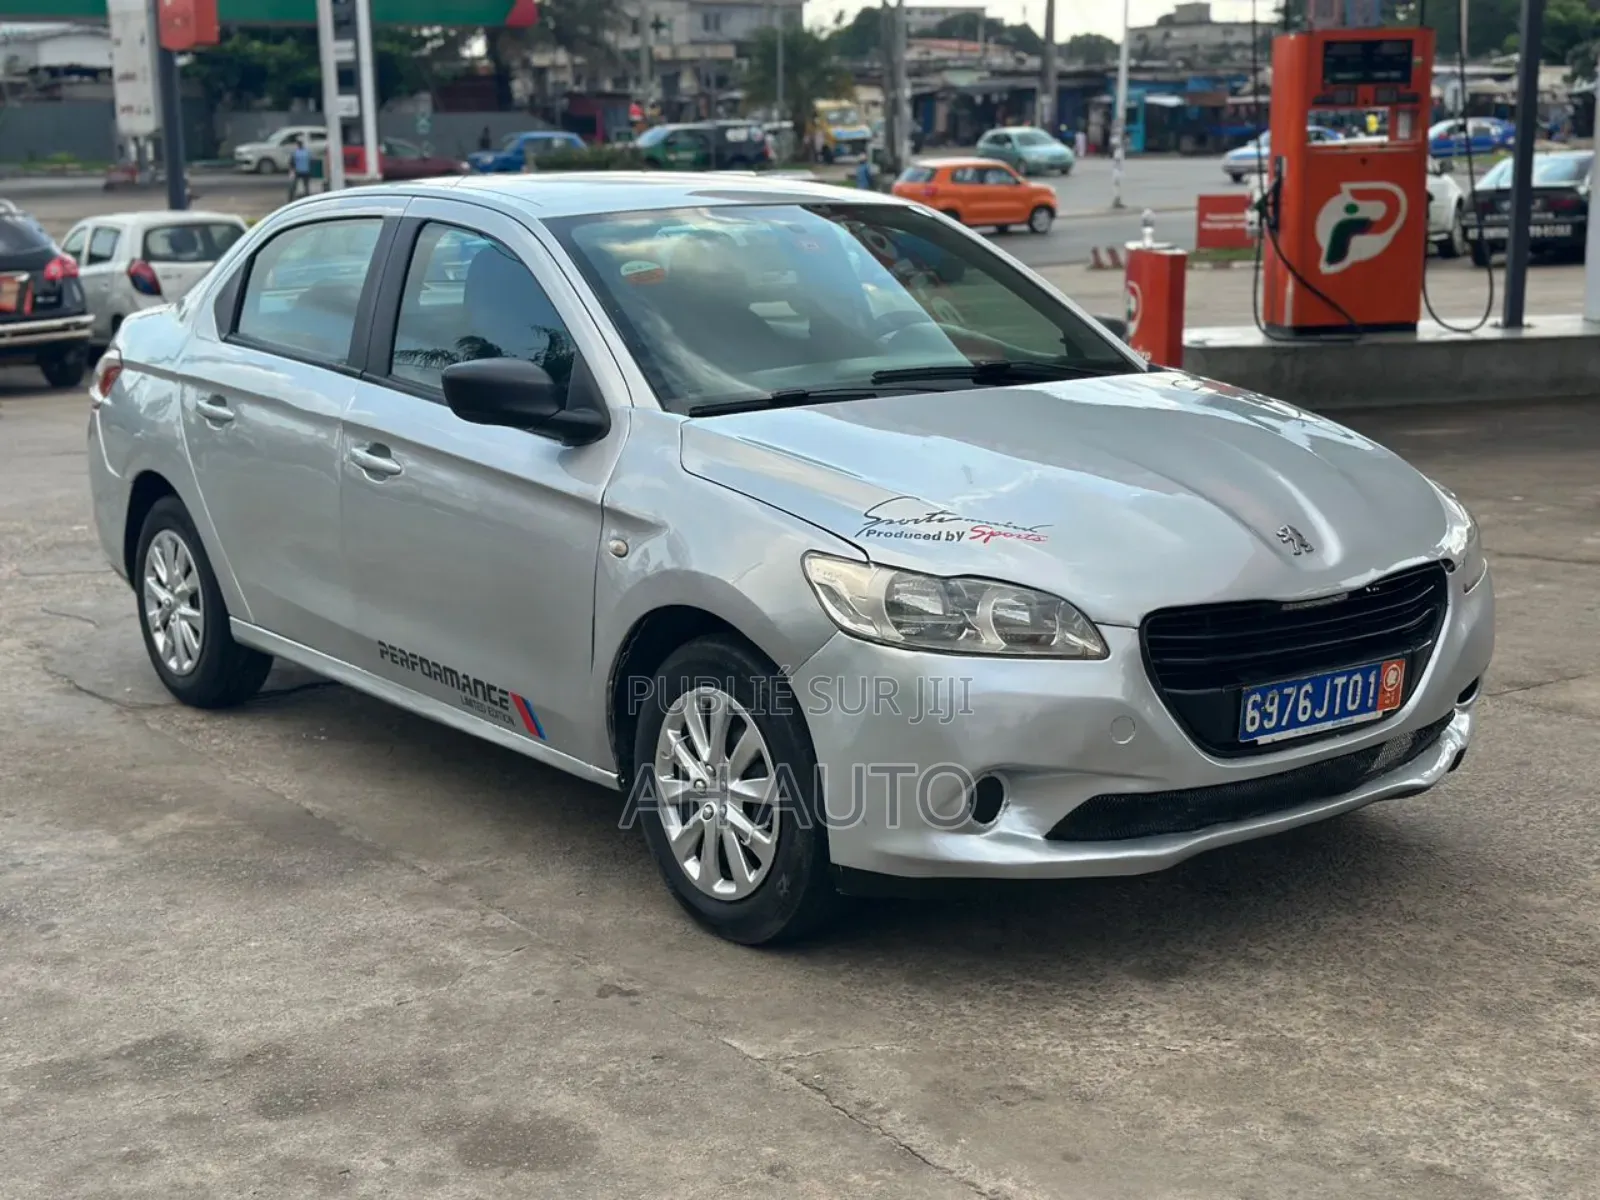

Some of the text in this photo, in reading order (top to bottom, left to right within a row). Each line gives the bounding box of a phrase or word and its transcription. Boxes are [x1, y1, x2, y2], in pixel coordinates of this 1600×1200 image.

[865, 524, 1049, 545] Produced by Sports
[378, 640, 510, 711] PERFORMANCE
[460, 694, 487, 713] LIMITED
